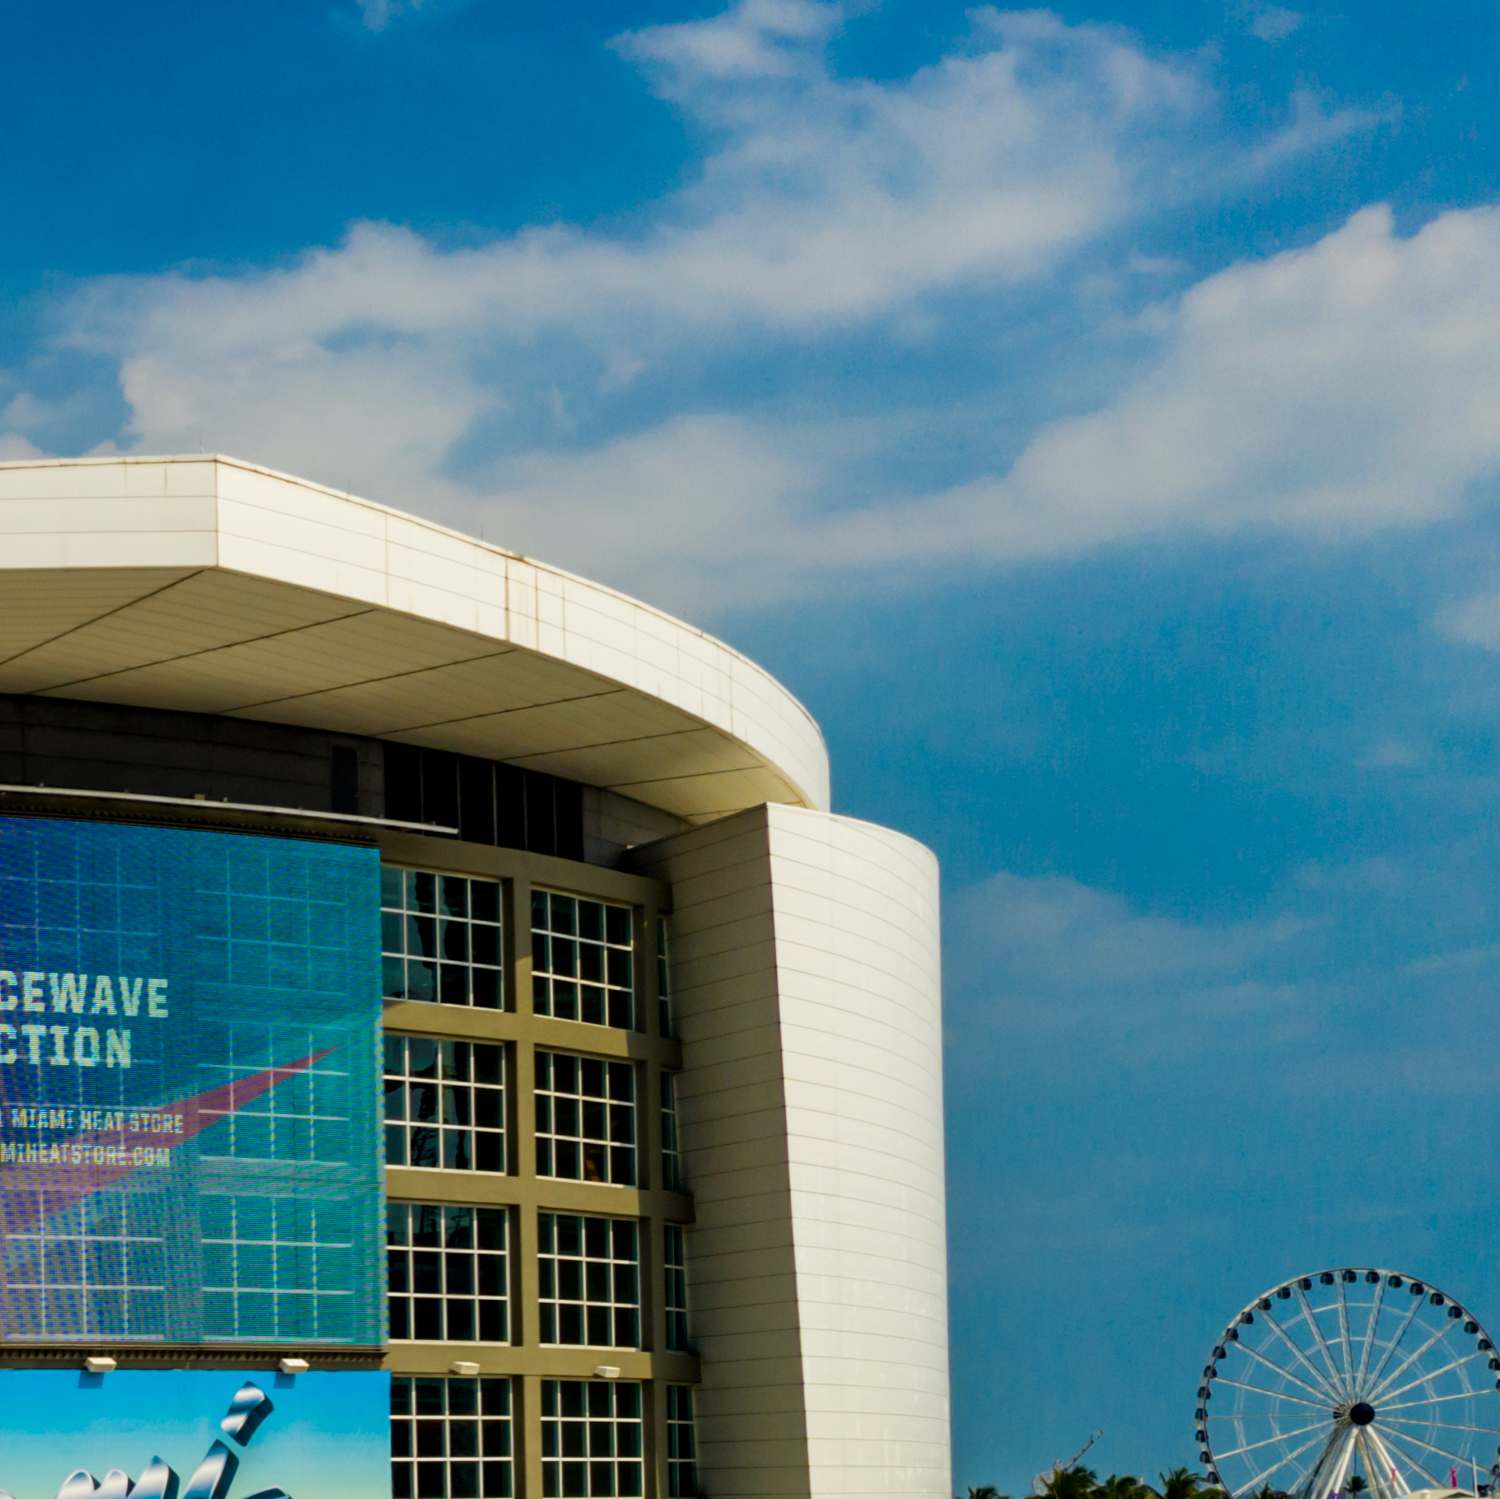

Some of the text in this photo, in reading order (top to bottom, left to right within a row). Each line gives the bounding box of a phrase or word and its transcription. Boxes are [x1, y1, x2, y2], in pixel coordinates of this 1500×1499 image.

[12, 1108, 75, 1130] MIAMI
[80, 1110, 123, 1131] HEAT
[129, 1112, 184, 1134] STORE
